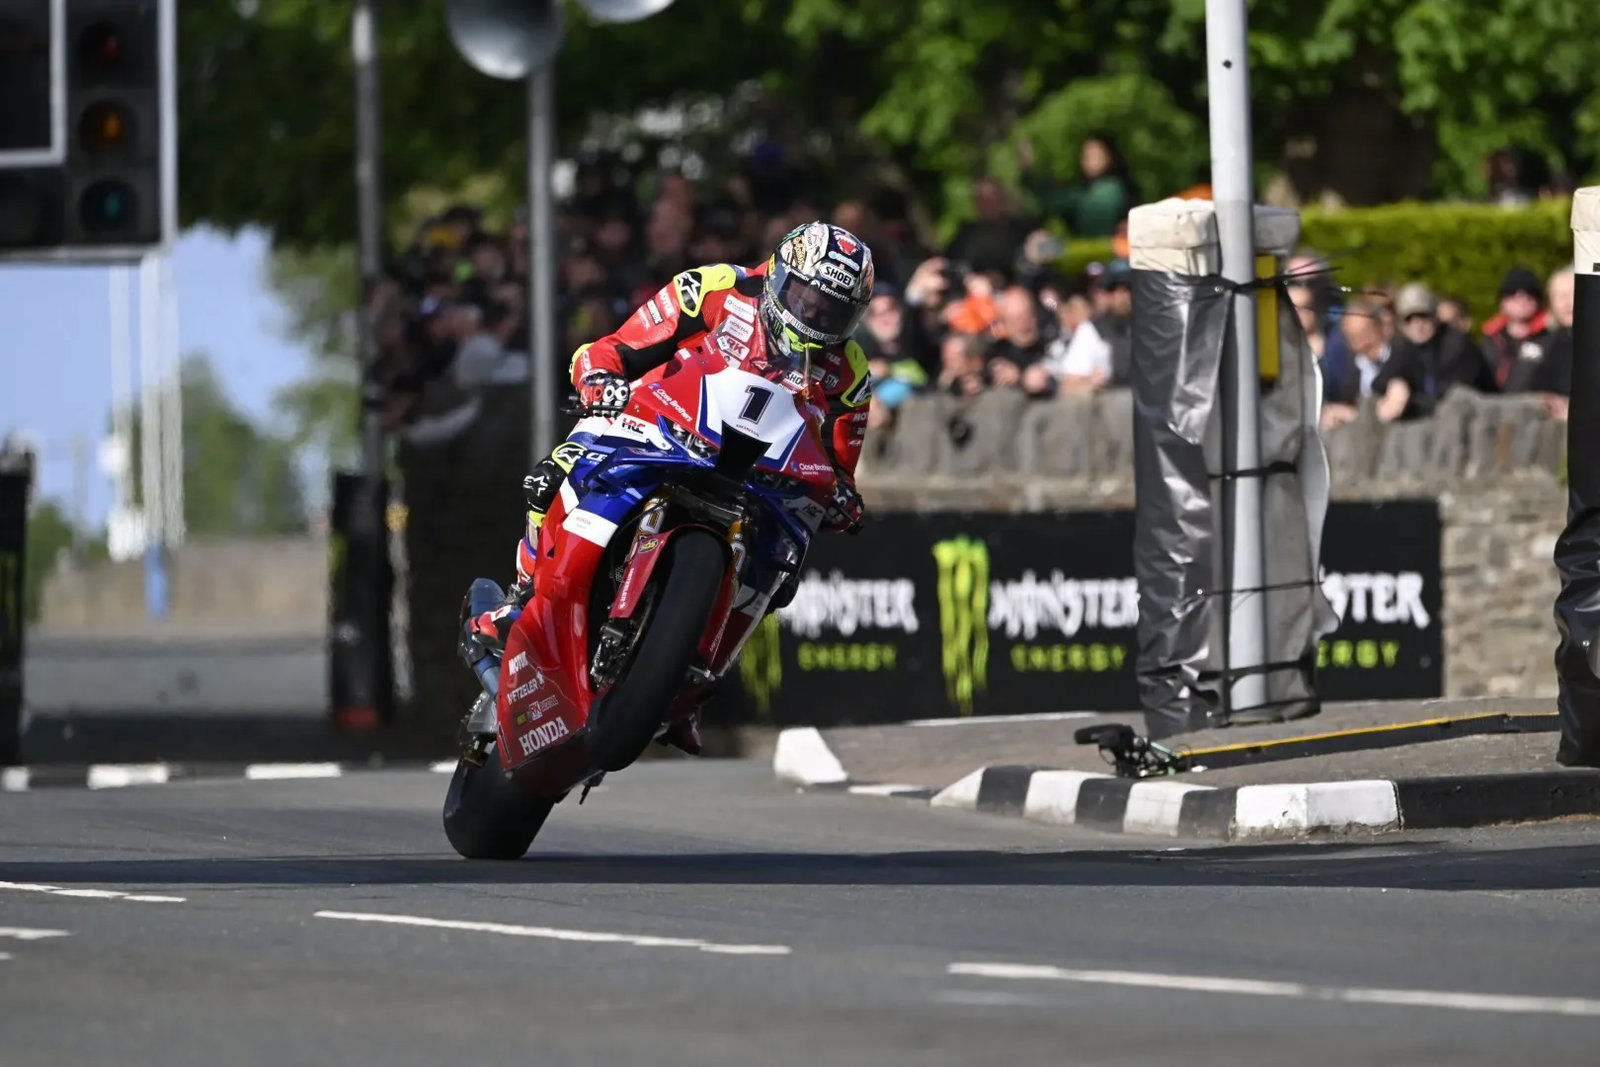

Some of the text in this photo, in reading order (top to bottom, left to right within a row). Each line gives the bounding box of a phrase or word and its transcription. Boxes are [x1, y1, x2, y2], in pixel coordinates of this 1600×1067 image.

[824, 265, 852, 287] SHOEI
[820, 284, 850, 304] Bennetts
[727, 338, 745, 354] RK
[785, 371, 803, 385] SHO
[738, 384, 775, 425] 1
[621, 417, 646, 434] HRC
[798, 642, 898, 672] ENERGY
[1010, 642, 1127, 673] ENERGY
[518, 716, 569, 756] HONDA
